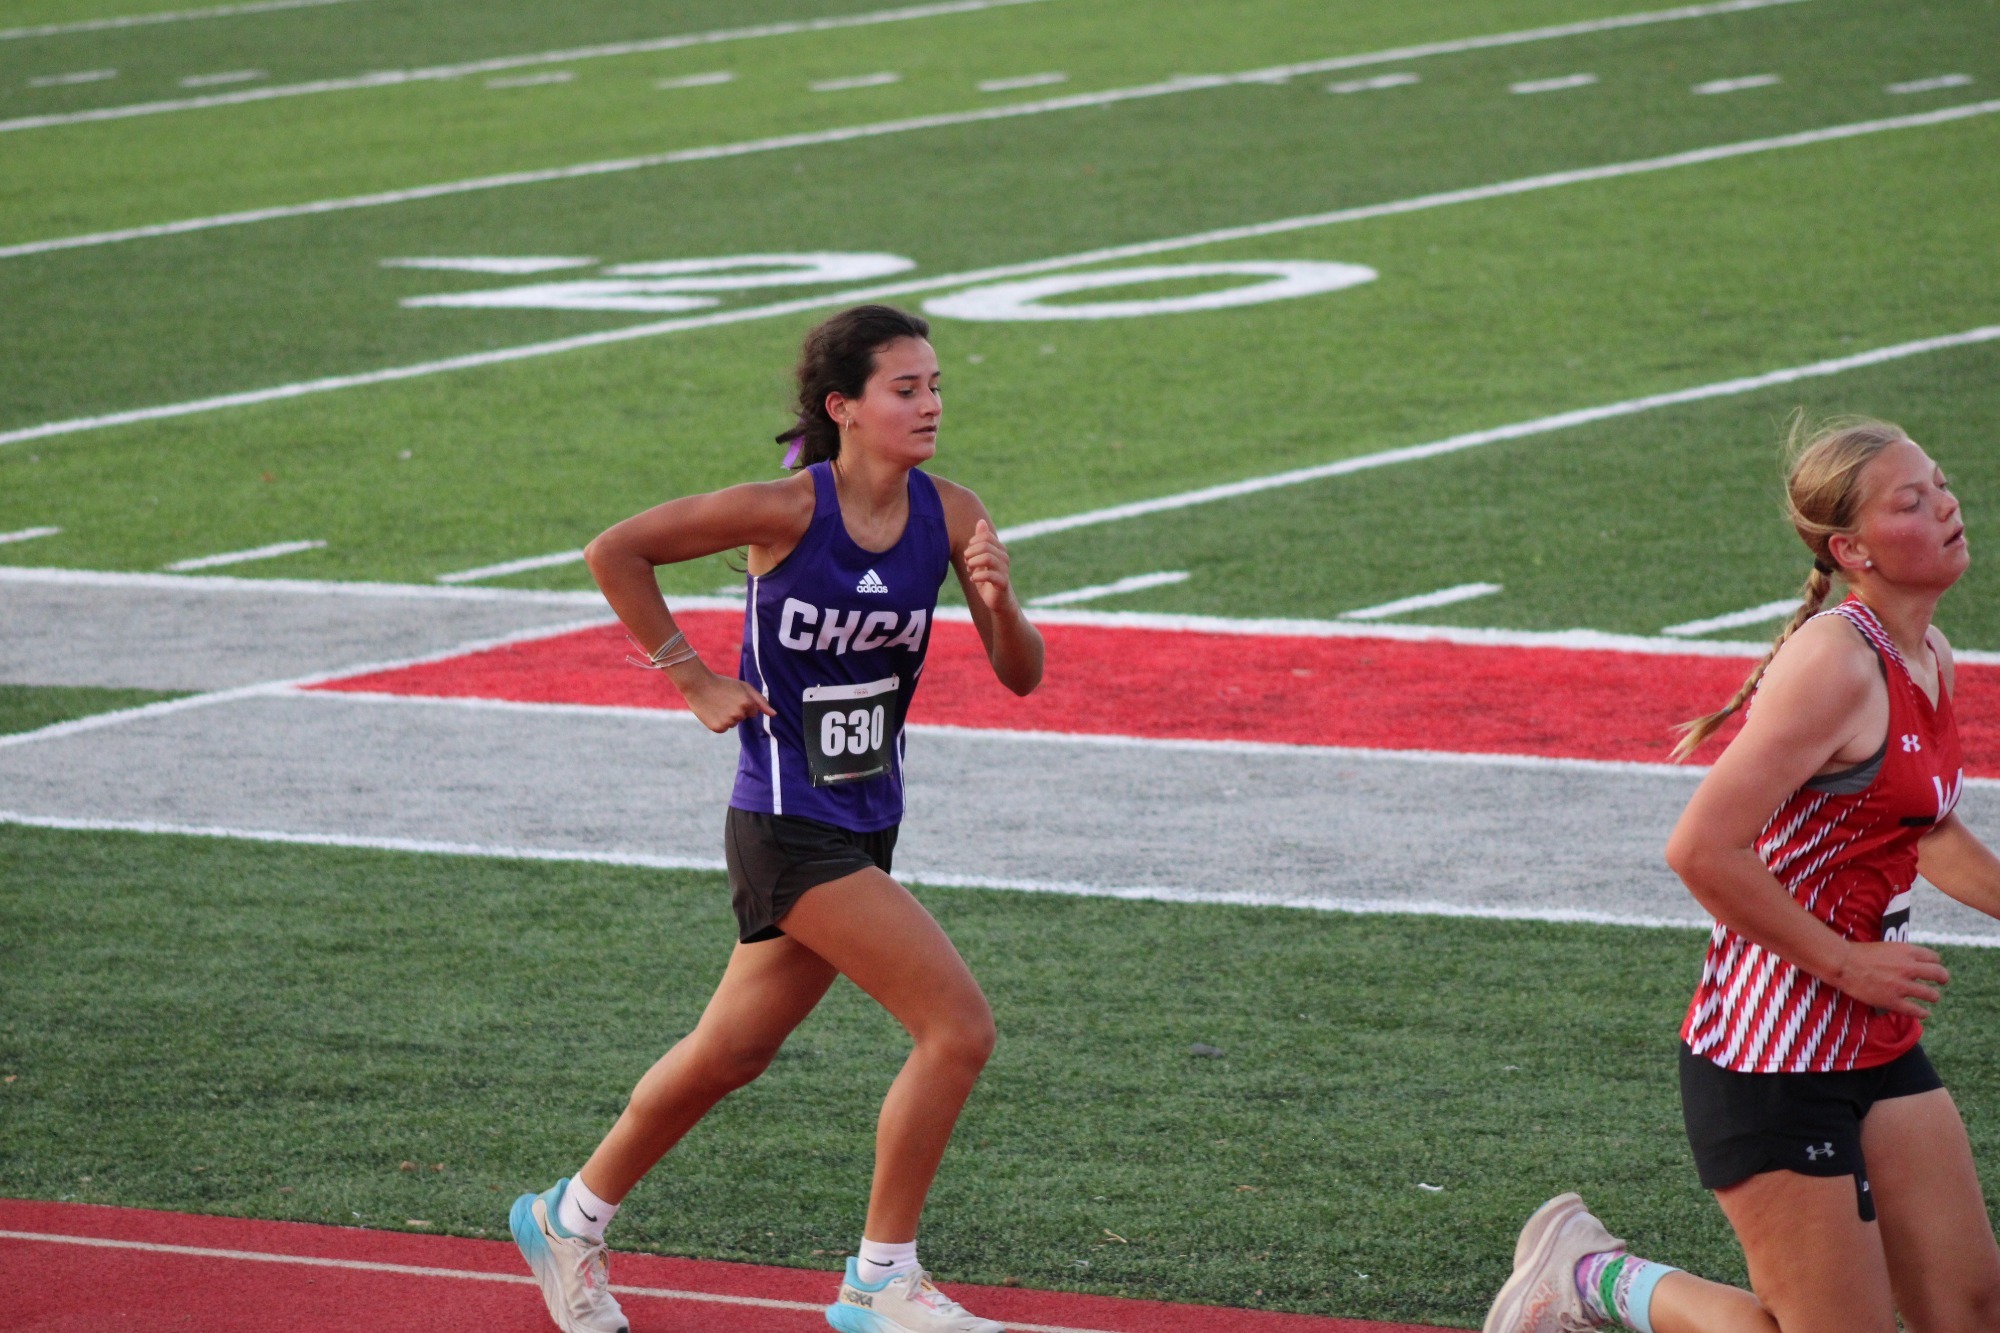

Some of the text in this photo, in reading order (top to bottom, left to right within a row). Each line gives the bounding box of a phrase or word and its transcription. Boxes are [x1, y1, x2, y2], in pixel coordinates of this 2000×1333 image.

[856, 583, 889, 594] adidas
[778, 597, 927, 656] CHCA
[820, 704, 885, 757] 630
